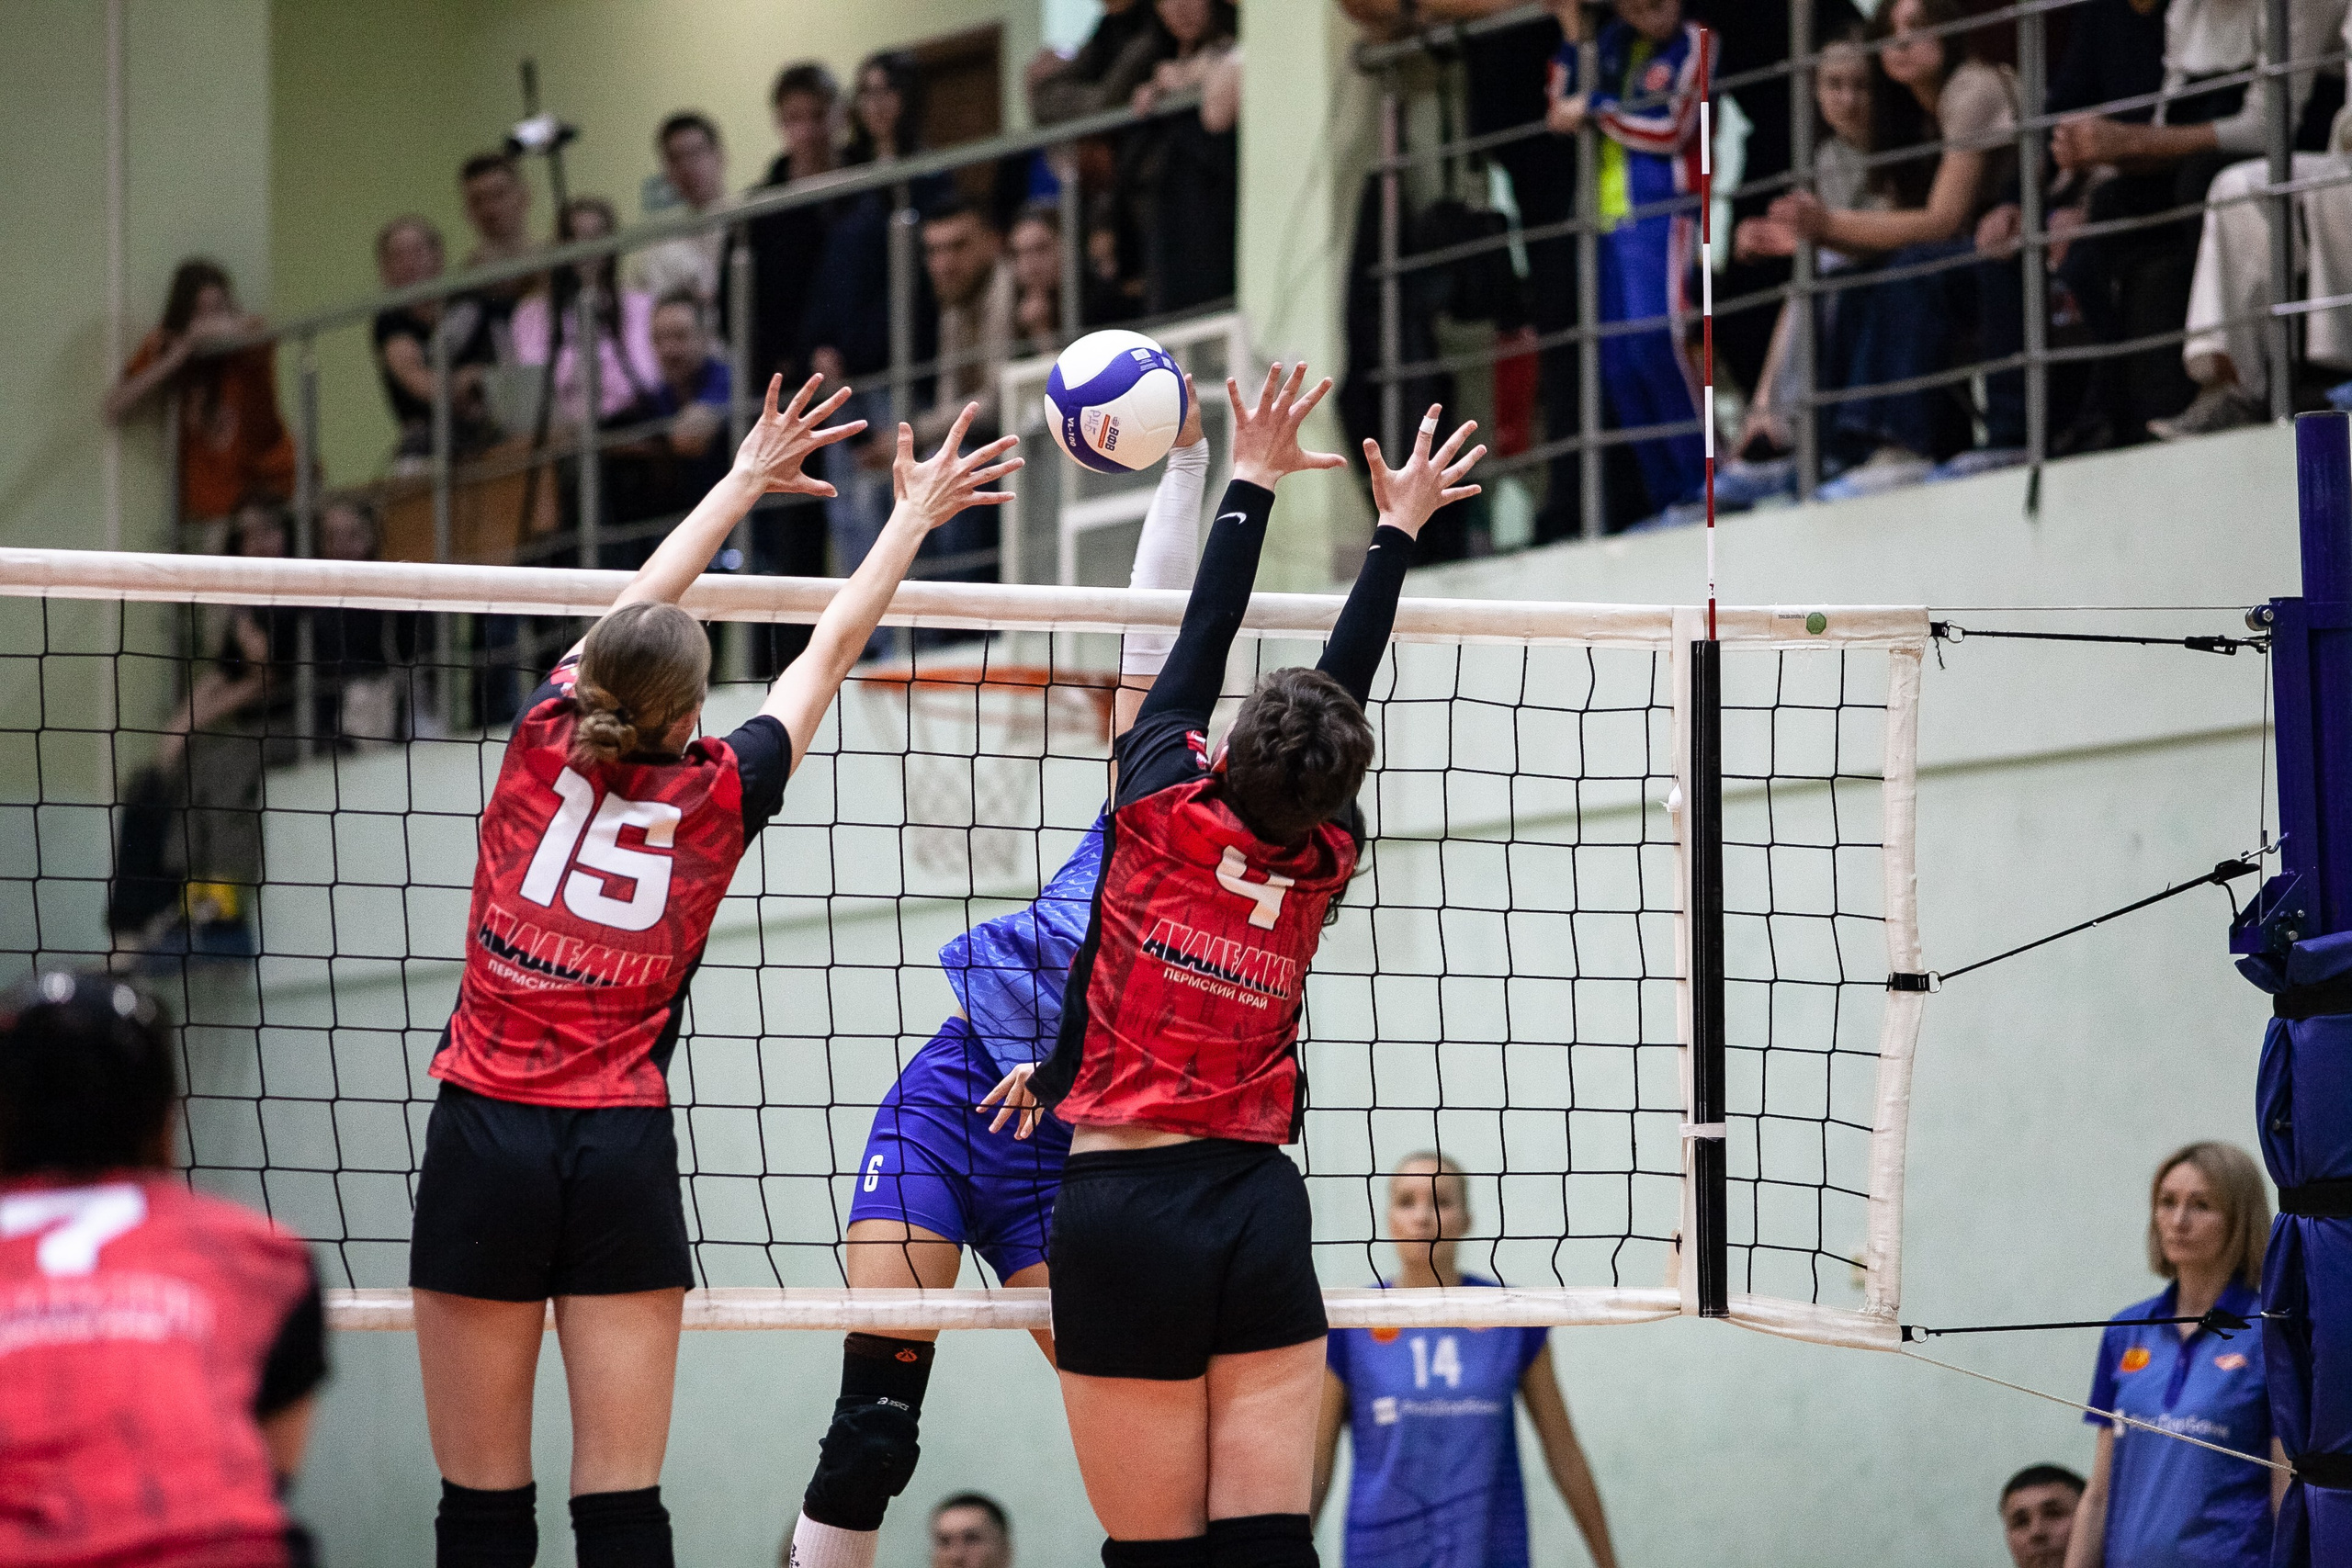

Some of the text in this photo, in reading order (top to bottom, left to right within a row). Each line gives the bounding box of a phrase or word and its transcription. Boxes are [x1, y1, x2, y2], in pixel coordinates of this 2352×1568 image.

[1067, 416, 1077, 447] VL-100
[1104, 426, 1120, 452] ВФВ
[519, 765, 683, 931] 15
[1216, 844, 1295, 931] 4
[1140, 918, 1296, 1000] АКАДЕМИЯ
[1163, 966, 1269, 1010] ПЕРМСКИЙ КРАЙ
[863, 1154, 885, 1193] 6
[0, 1180, 147, 1277] 7
[1408, 1335, 1463, 1389] 14
